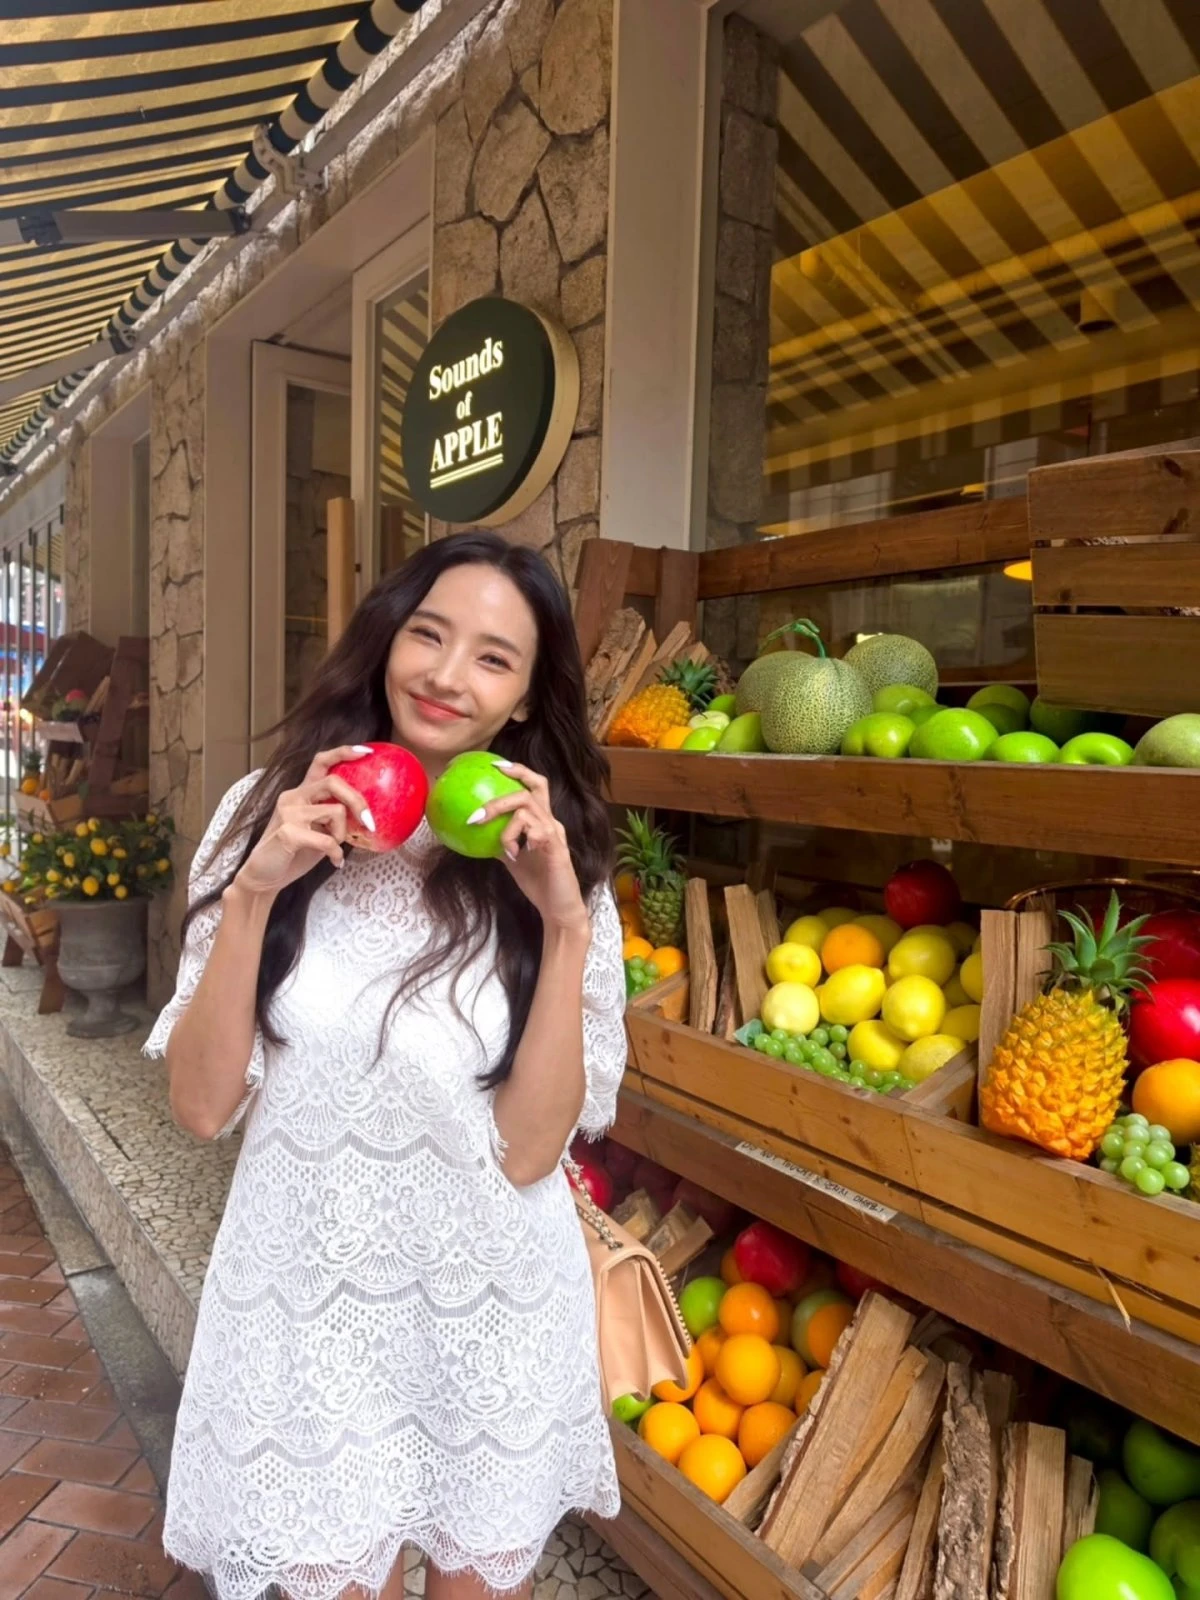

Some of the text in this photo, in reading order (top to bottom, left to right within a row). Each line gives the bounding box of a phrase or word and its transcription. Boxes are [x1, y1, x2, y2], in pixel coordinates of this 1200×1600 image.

[429, 337, 504, 400] Sounds
[456, 391, 473, 420] of
[430, 411, 503, 472] APPLE
